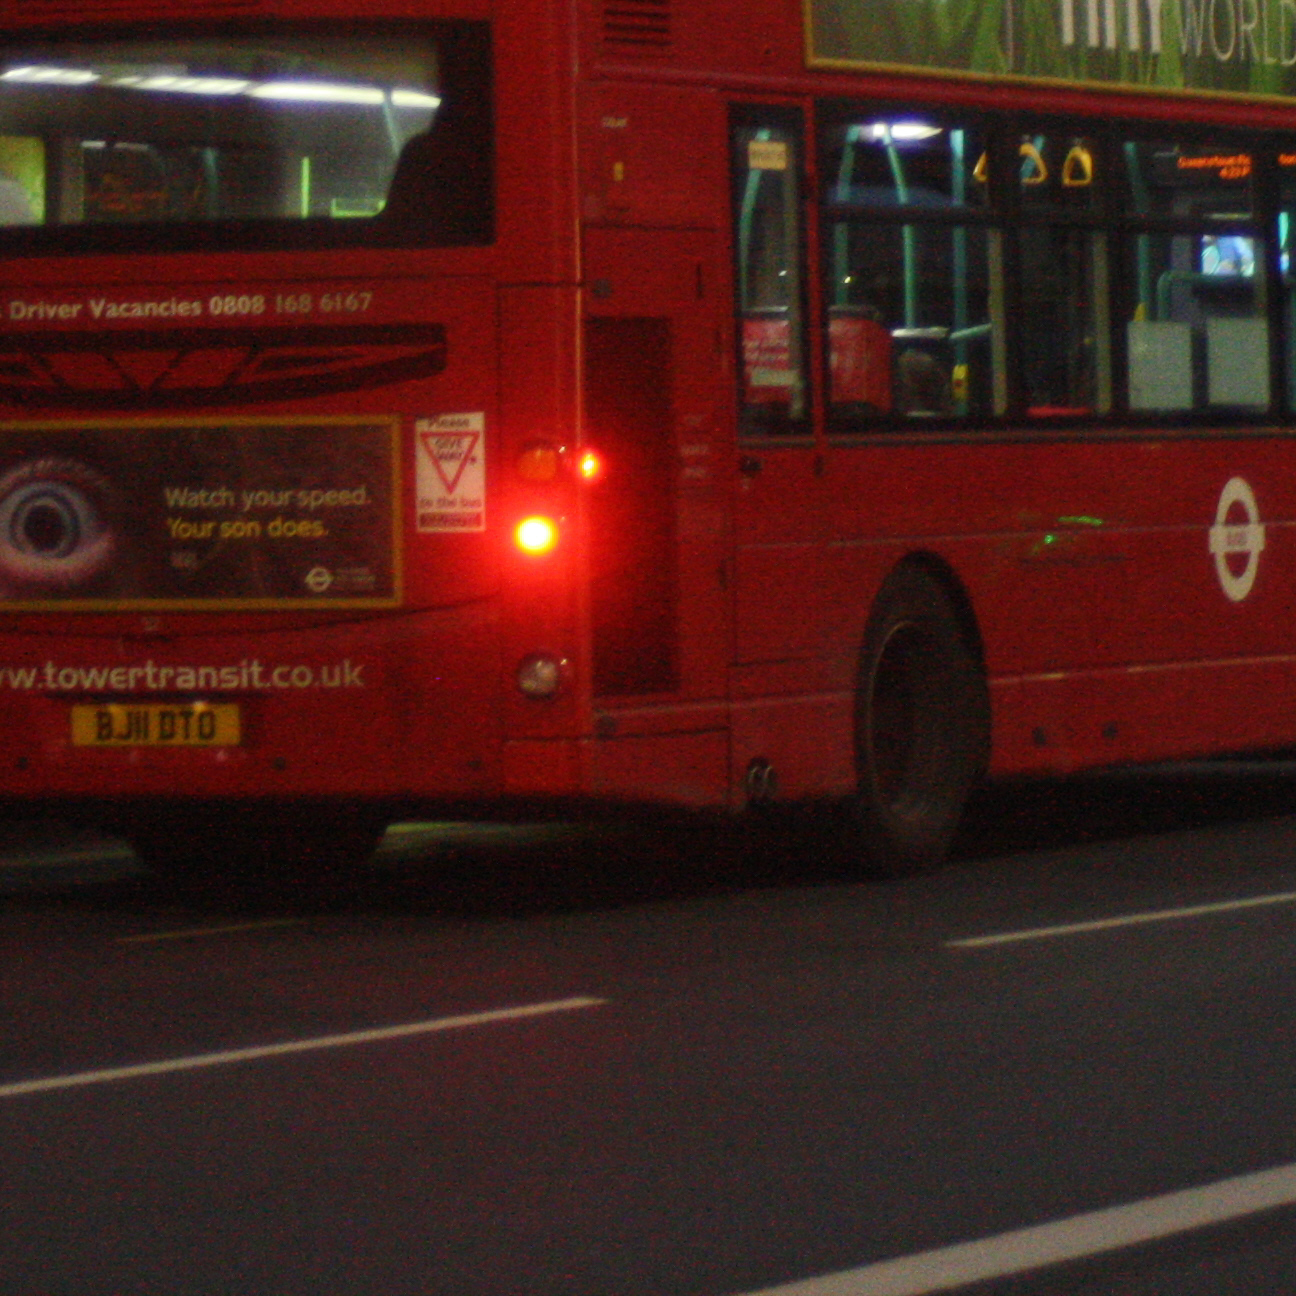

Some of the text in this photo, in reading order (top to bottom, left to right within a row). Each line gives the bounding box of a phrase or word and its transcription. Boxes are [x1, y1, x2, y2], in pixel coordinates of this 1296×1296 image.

[10, 299, 83, 320] Driver
[90, 297, 203, 319] Vacancies
[208, 294, 266, 317] 0808
[275, 293, 313, 313] 168
[320, 291, 373, 312] 6167
[165, 484, 371, 512] Watch your speed.
[167, 515, 329, 538] Your son does.
